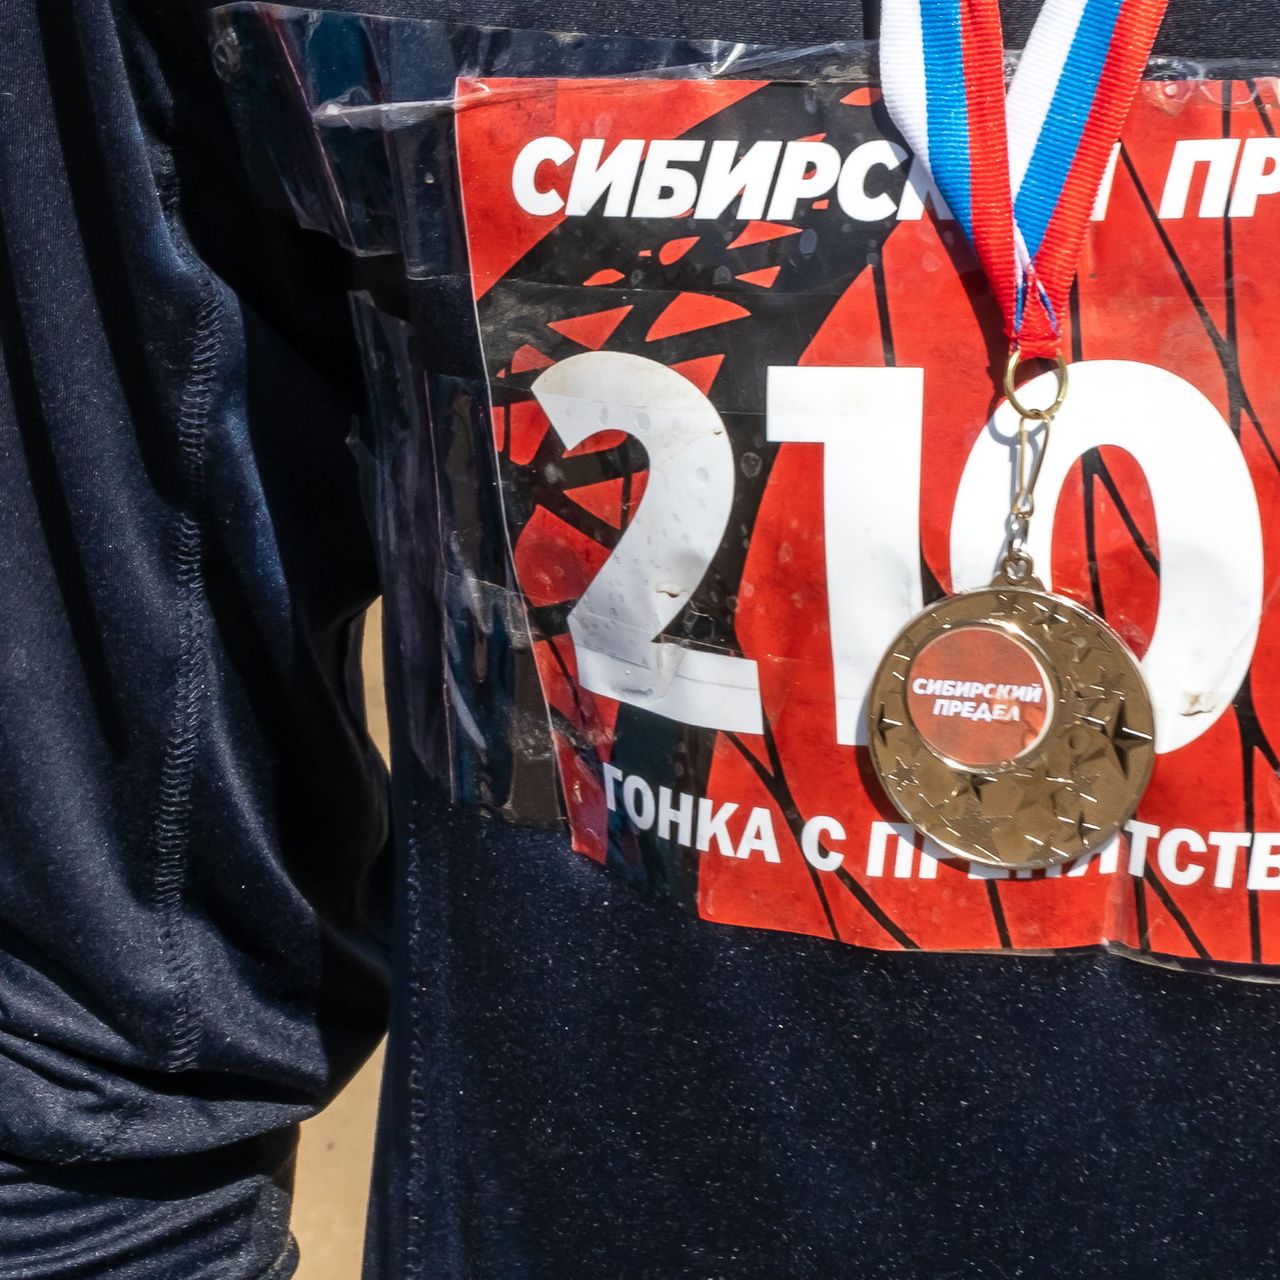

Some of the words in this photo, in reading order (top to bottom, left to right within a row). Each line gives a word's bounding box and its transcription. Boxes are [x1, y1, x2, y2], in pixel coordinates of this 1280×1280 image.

[511, 136, 1122, 221] СИБИРСК
[912, 677, 1043, 703] СИБИРСКИЙ
[932, 698, 1020, 722] ПРЕДЕЛ
[603, 762, 781, 864] ГОНКА
[801, 815, 847, 872] С
